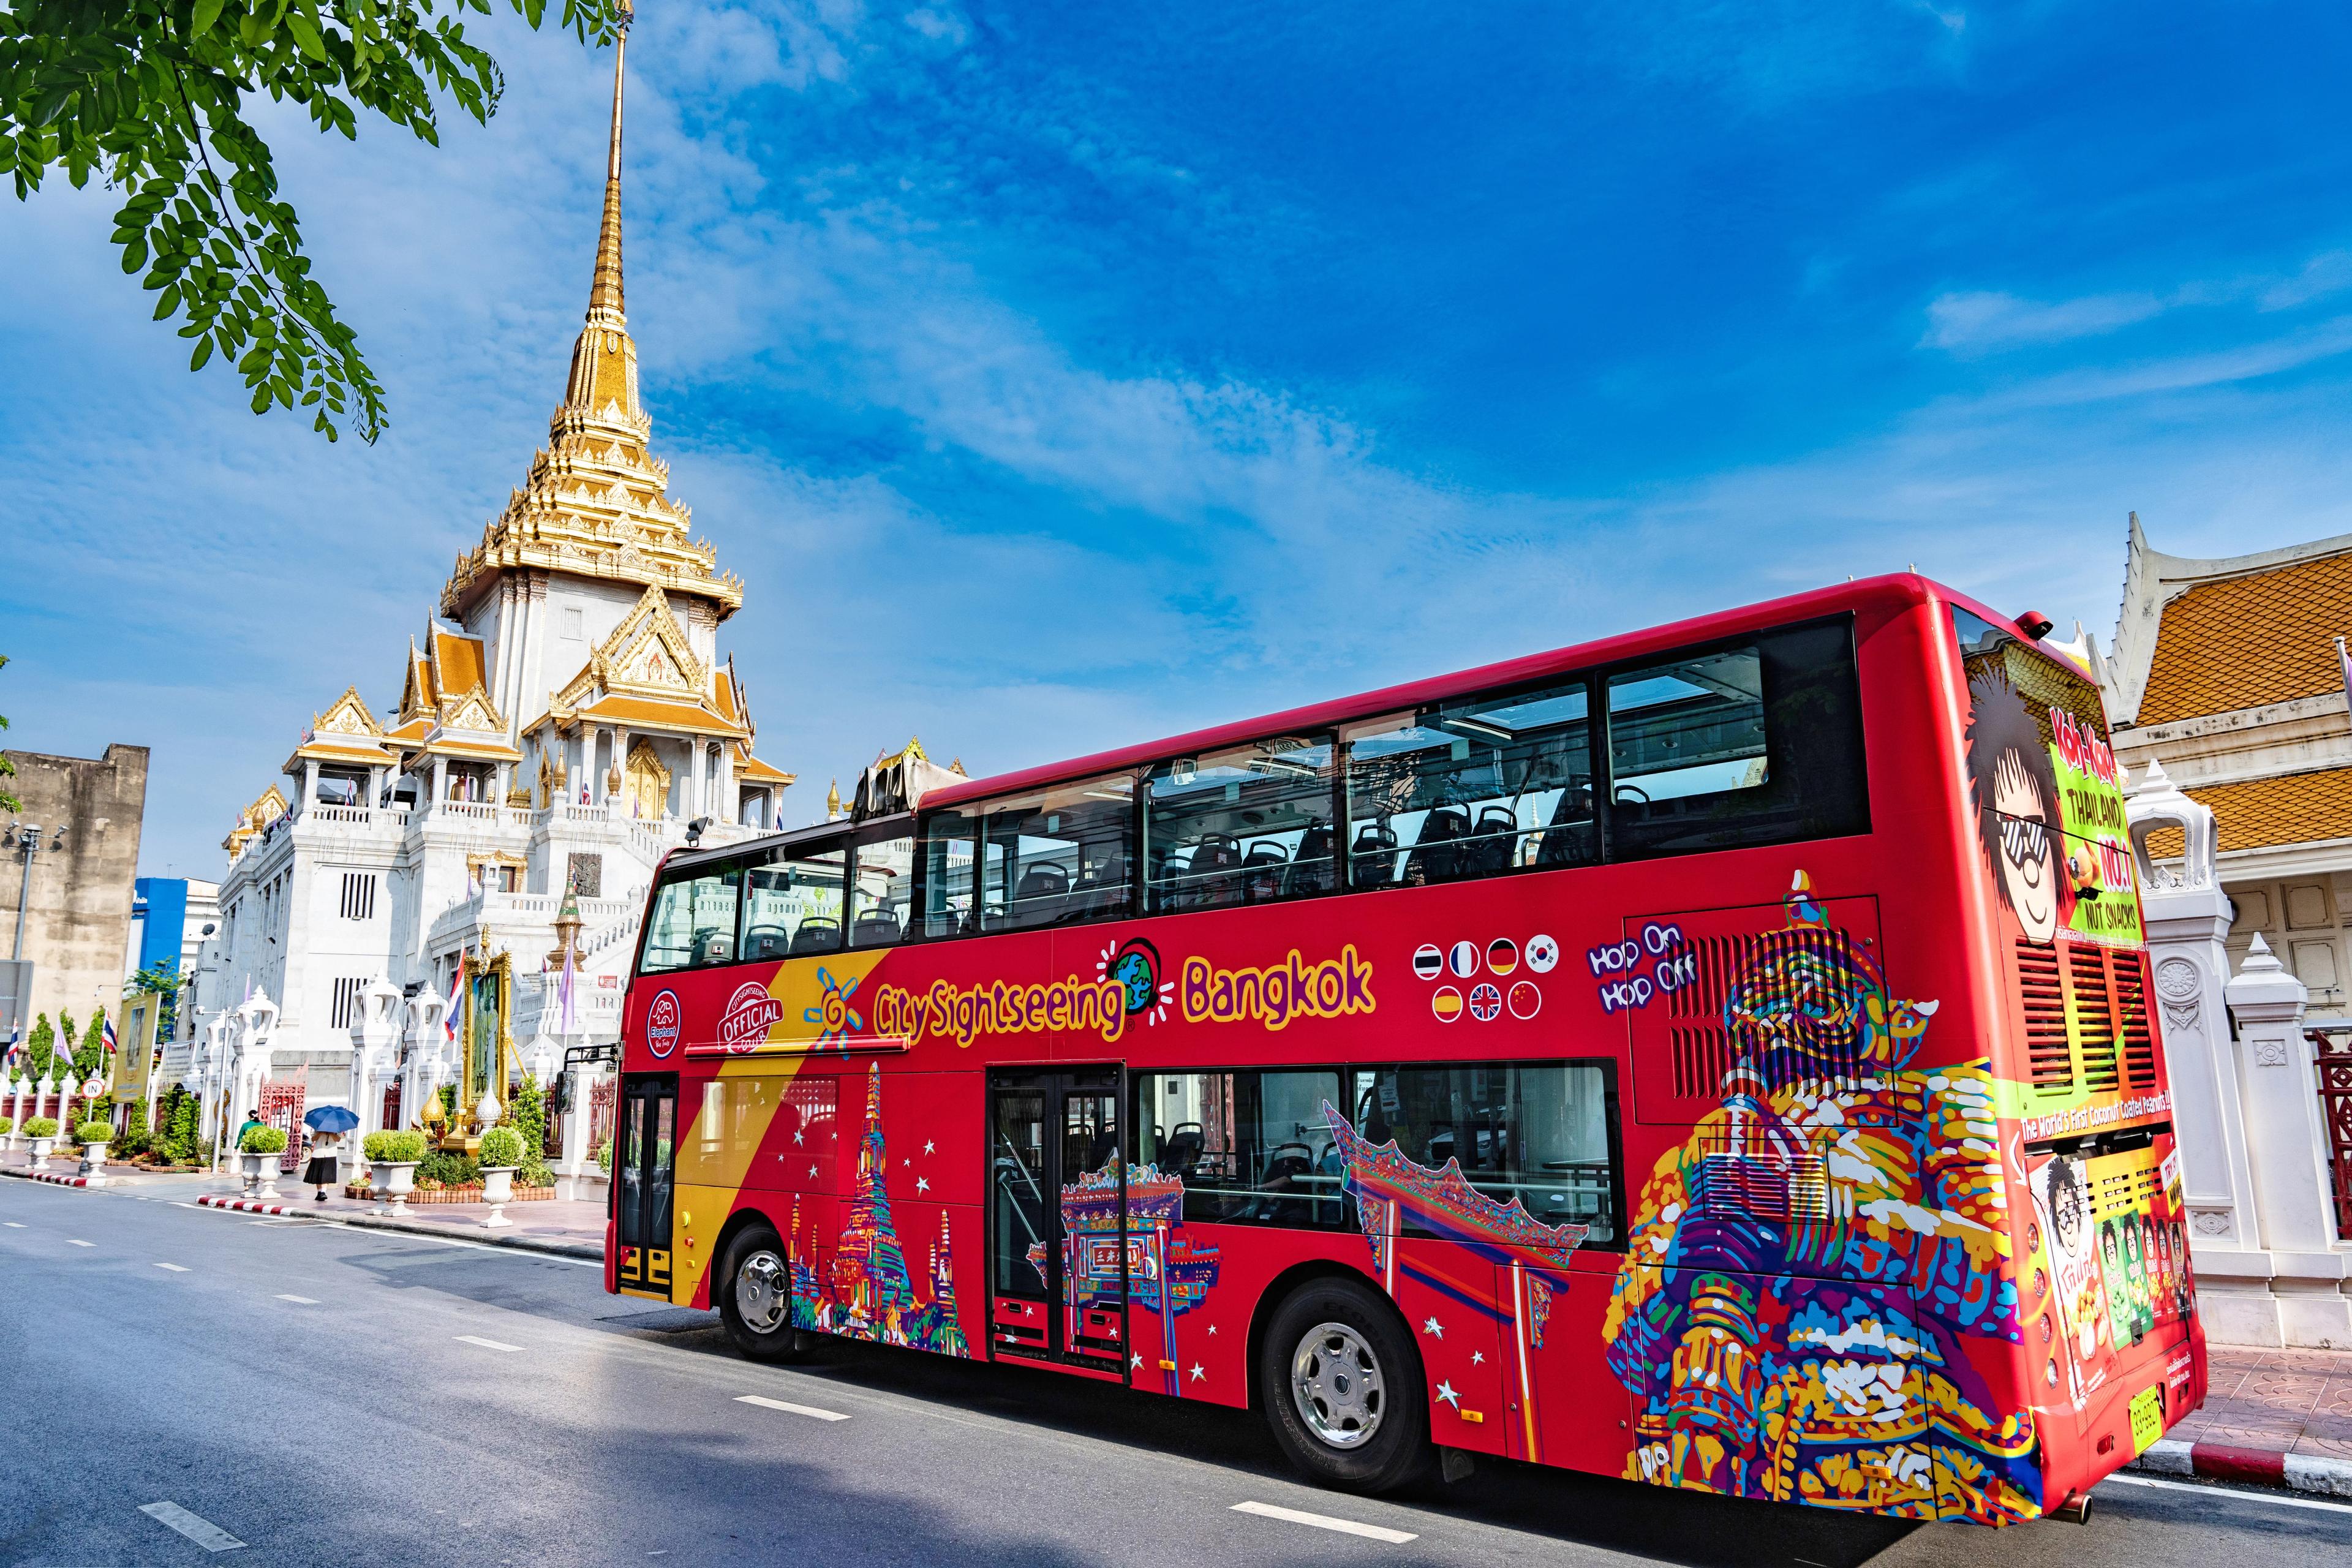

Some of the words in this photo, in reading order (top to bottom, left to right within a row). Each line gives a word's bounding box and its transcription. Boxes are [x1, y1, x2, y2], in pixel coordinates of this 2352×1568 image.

[2049, 706, 2117, 791] Koh-Kae
[2067, 788, 2122, 831] THAILAND
[2097, 835, 2132, 892] NO.1
[2084, 902, 2103, 930] NUT
[2107, 903, 2136, 930] SNACKS
[1643, 925, 1681, 954] On
[1182, 944, 1376, 1031] Bangkok
[1656, 953, 1696, 991] Off
[731, 987, 766, 1011] CITYSIGHTSEEING
[650, 1025, 676, 1039] Elephant
[724, 1003, 780, 1041] OFFICIAL
[737, 1030, 766, 1051] TOUR
[88, 1085, 97, 1093] IN
[2021, 1117, 2038, 1141] The
[2038, 1110, 2070, 1137] World's
[2071, 1105, 2088, 1130] First
[2089, 1102, 2120, 1126] Coconut
[2120, 1096, 2143, 1120] Coated
[2133, 1397, 2158, 1437] 33-9927
